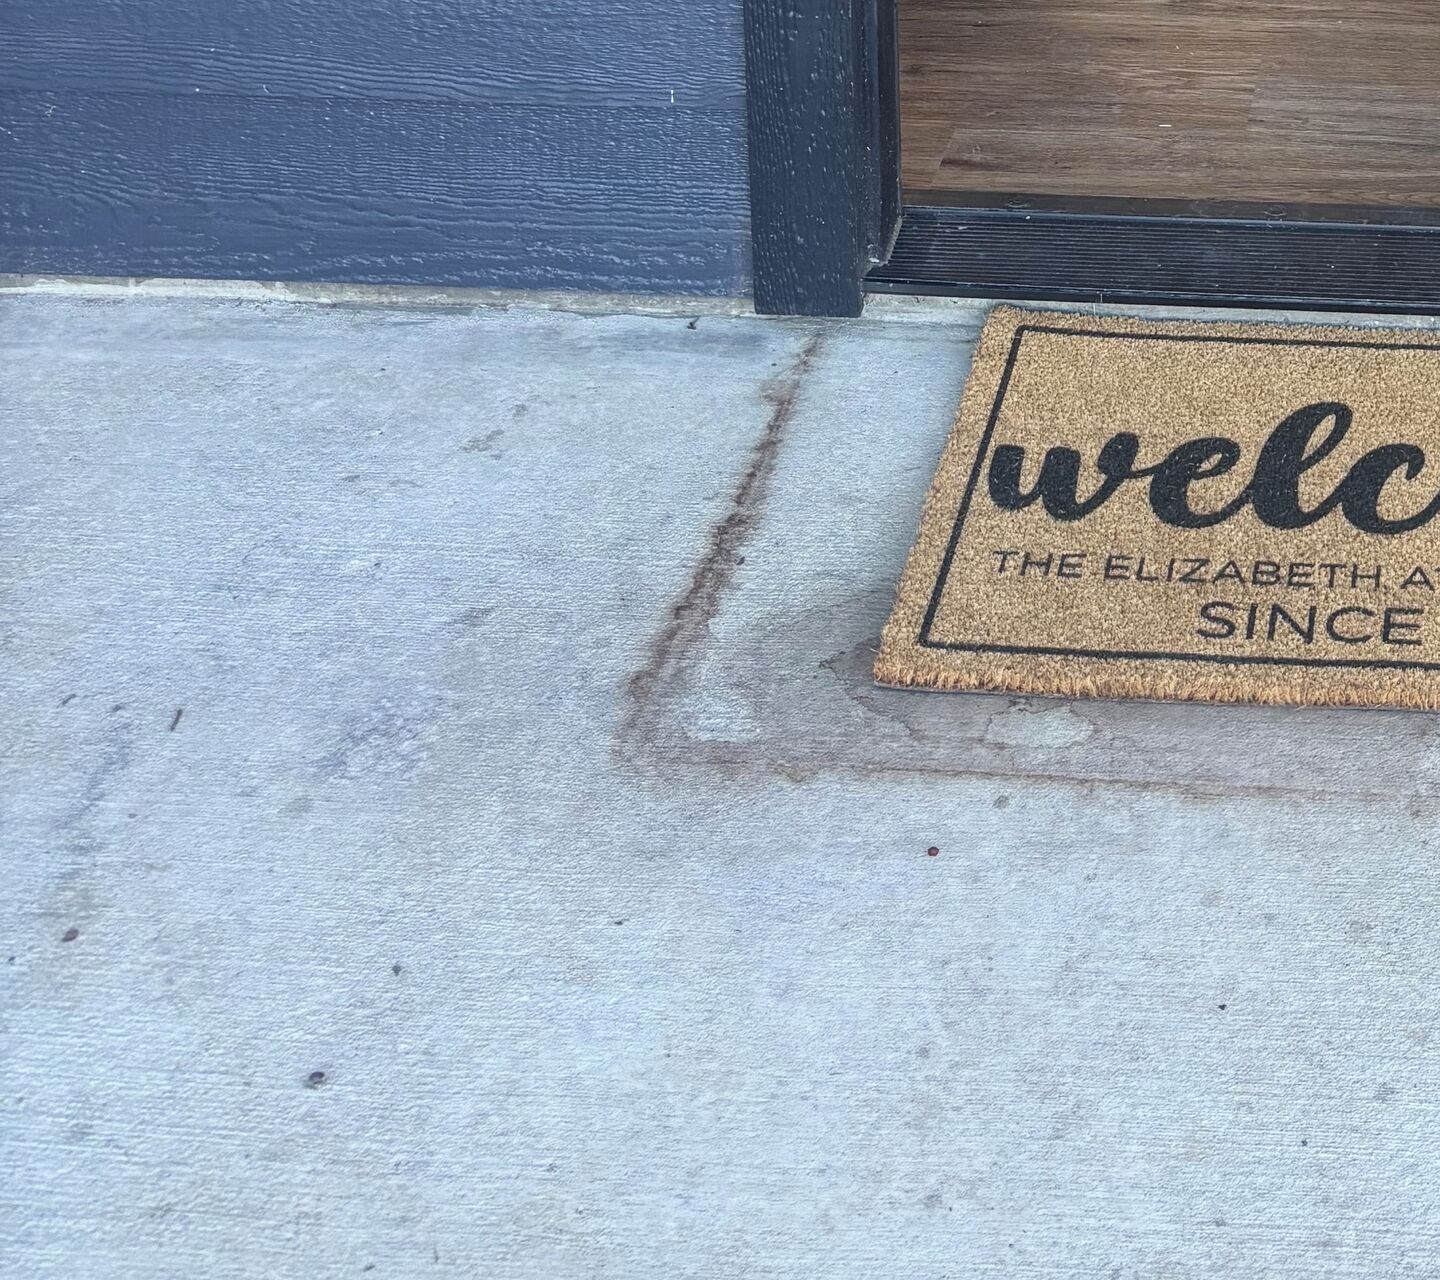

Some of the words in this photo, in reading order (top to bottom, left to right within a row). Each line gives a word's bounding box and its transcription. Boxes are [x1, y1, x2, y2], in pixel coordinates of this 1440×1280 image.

[992, 549, 1088, 579] THE
[1103, 554, 1382, 590] ELIZABETH
[1197, 601, 1424, 645] SINCE
